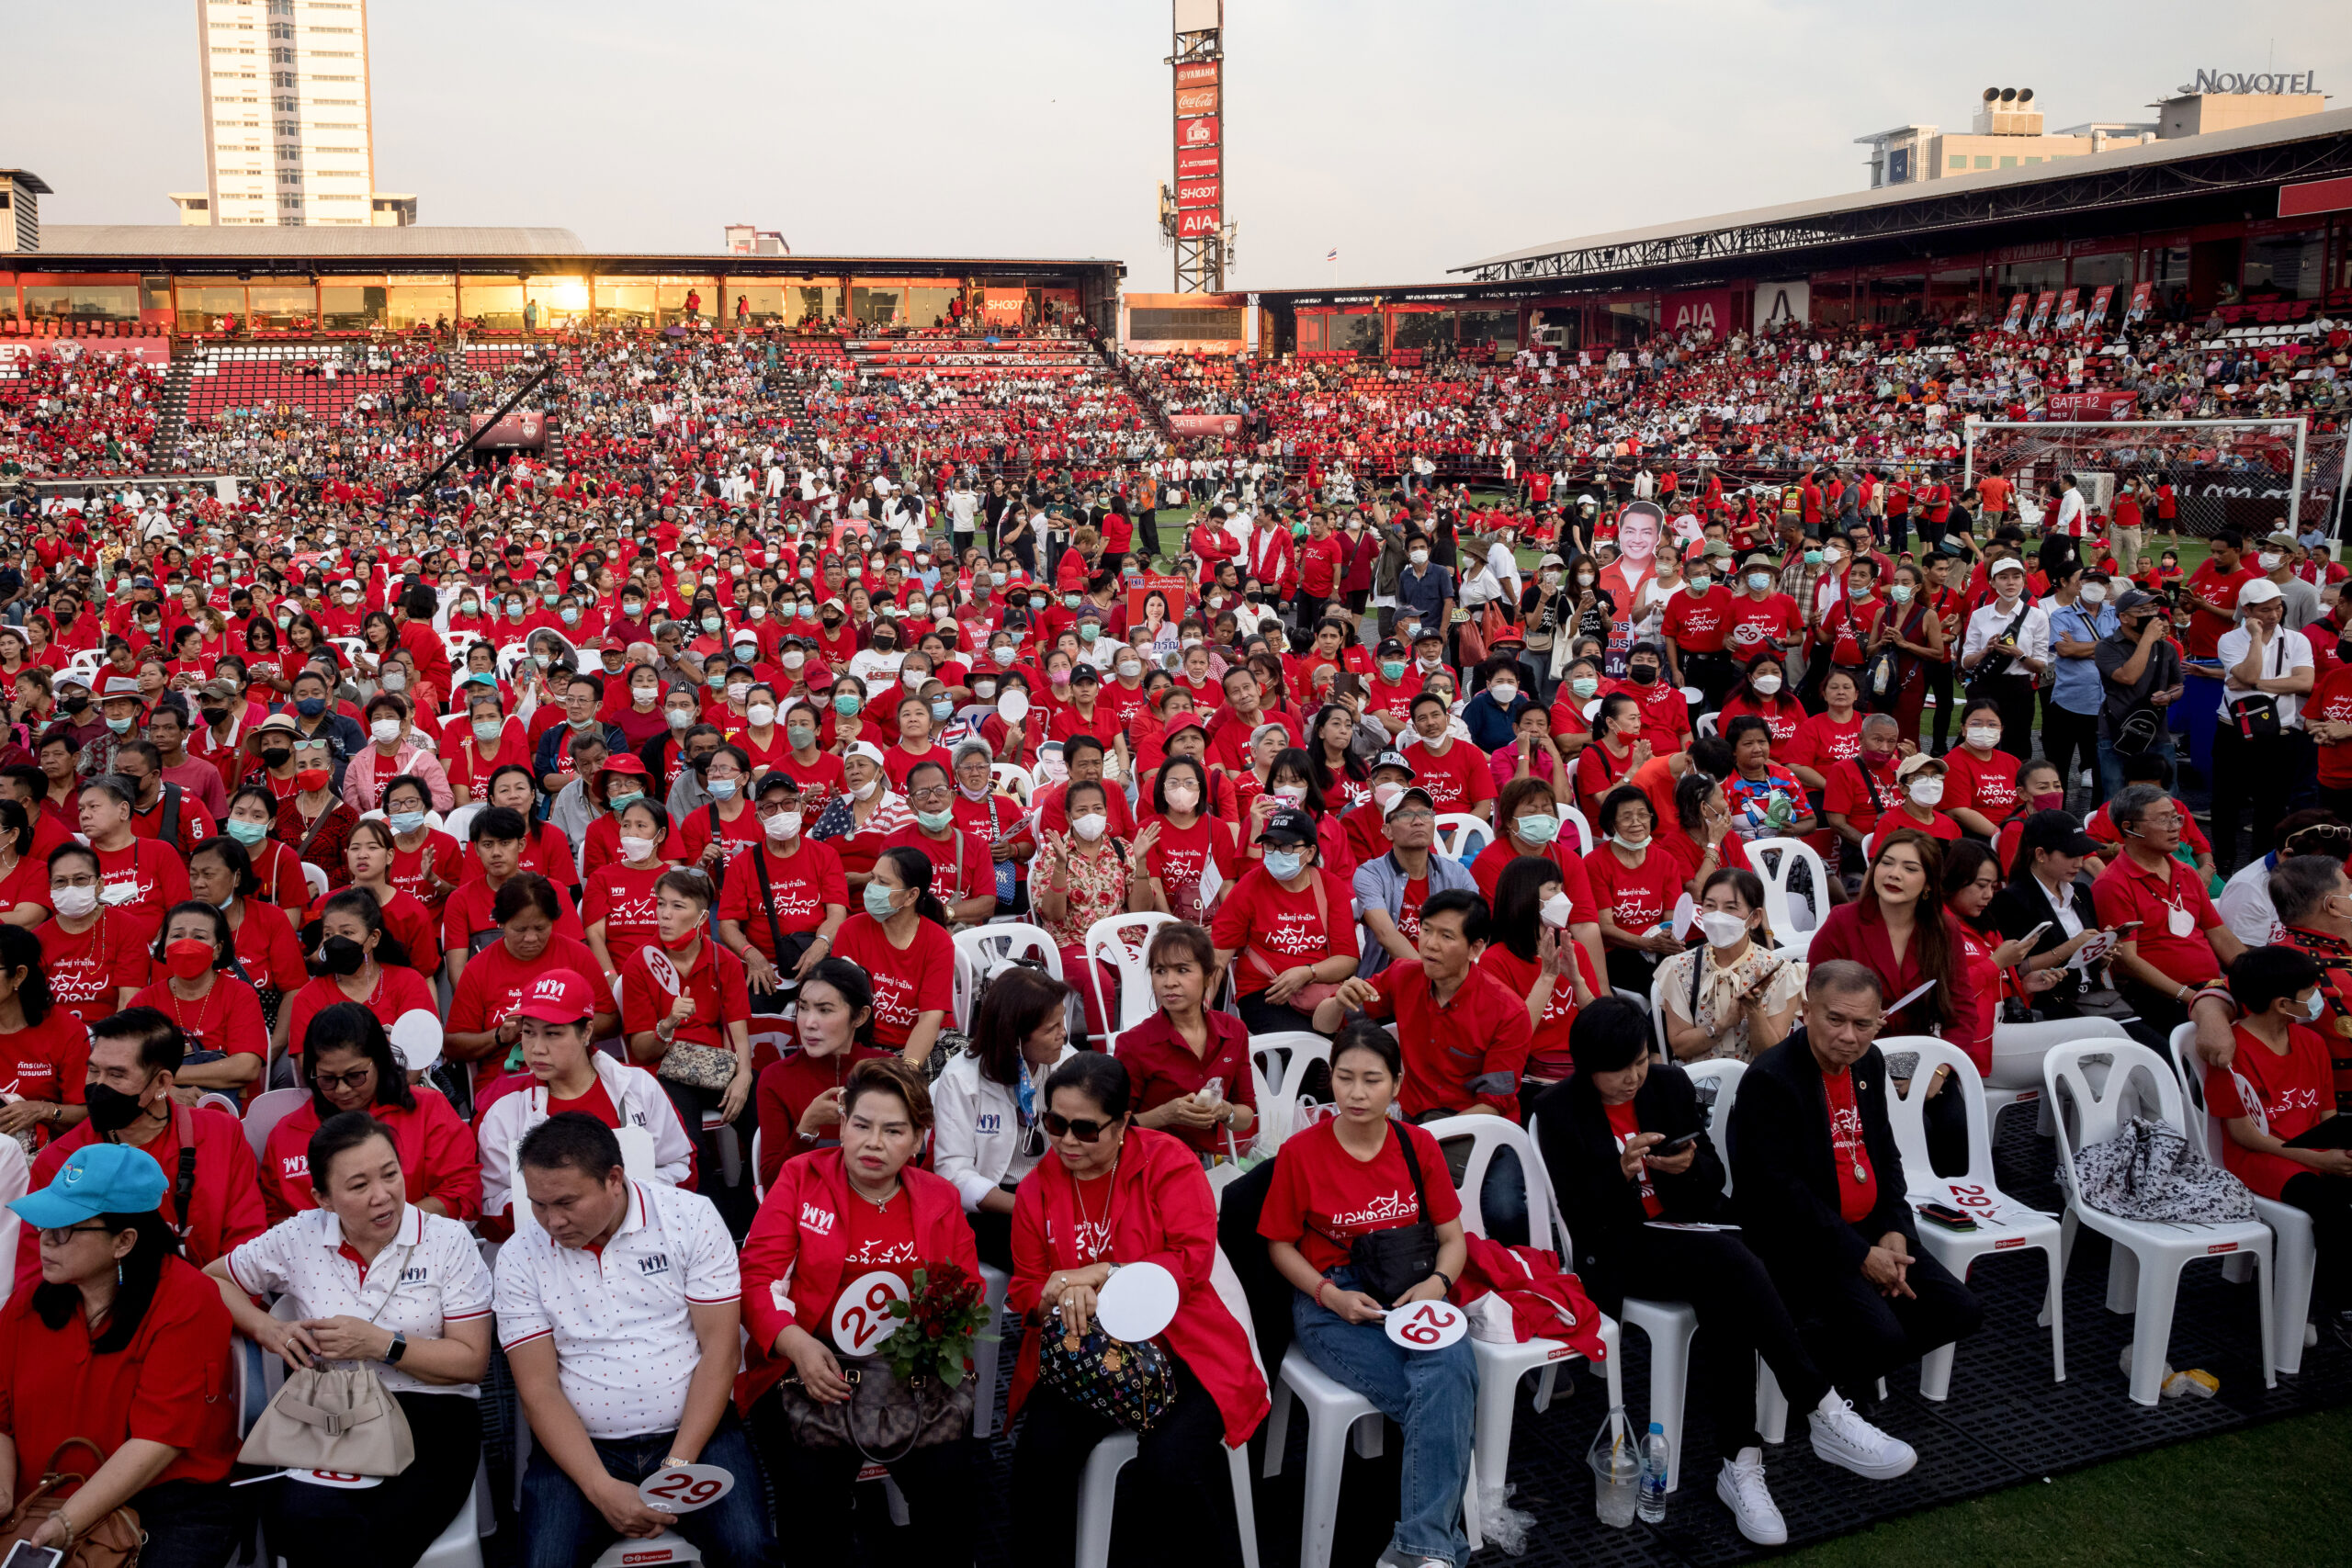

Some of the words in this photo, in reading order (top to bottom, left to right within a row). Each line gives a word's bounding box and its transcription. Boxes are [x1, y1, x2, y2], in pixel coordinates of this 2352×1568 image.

[1186, 68, 1215, 79] YAMAHA
[2195, 68, 2322, 94] NOVOTEL
[1188, 130, 1209, 141] LEO
[1181, 186, 1216, 198] SHOOT
[1183, 215, 1214, 231] AIA
[2013, 242, 2057, 258] YAMAHA
[987, 299, 1024, 310] SHOOT
[1675, 303, 1716, 331] AIA
[2051, 397, 2082, 409] GATE
[2086, 397, 2098, 408] 12
[505, 418, 512, 426] 2
[1172, 419, 1196, 427] GATE
[1785, 499, 1797, 508] 69
[1736, 626, 1758, 641] 29
[191, 818, 203, 840] LEO
[2082, 936, 2108, 963] 29
[651, 952, 672, 987] 29
[535, 979, 566, 997] พท
[1949, 1185, 1992, 1207] 29
[801, 1202, 834, 1230] พท
[638, 1254, 668, 1272] พท
[401, 1267, 427, 1281] พท
[841, 1282, 899, 1349] 29
[1400, 1304, 1456, 1345] 29
[646, 1473, 723, 1505] 29
